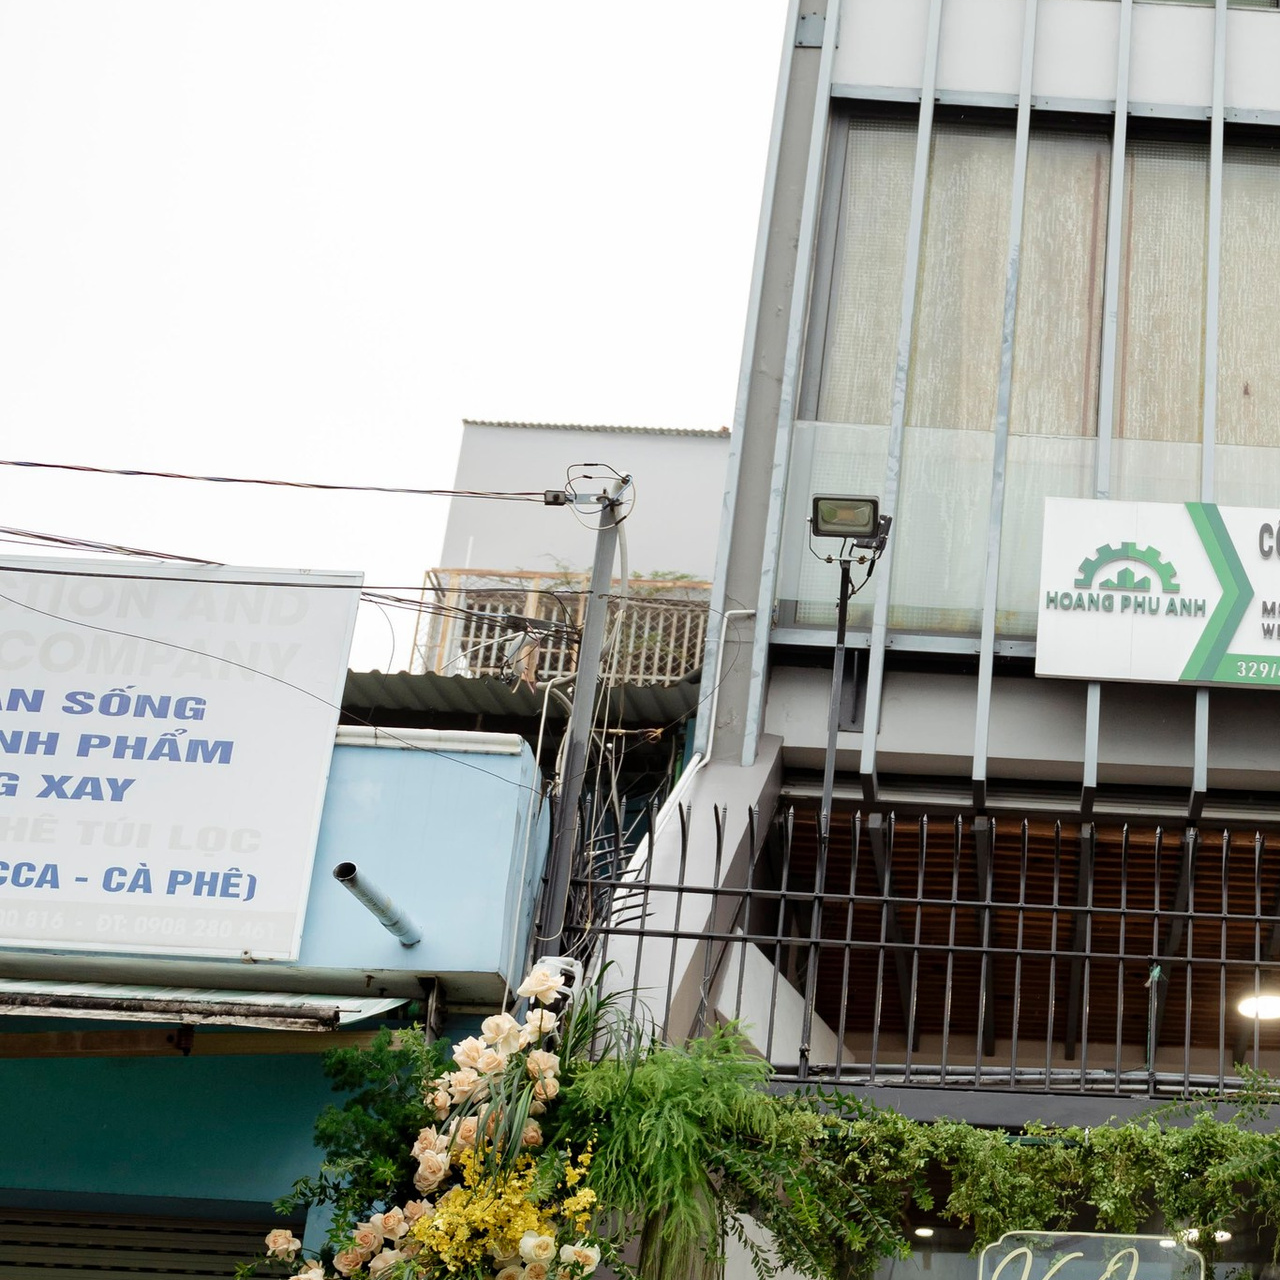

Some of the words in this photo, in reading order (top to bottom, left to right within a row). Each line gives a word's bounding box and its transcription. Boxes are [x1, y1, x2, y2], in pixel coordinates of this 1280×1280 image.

[1046, 590, 1114, 612] HOANG
[1121, 594, 1160, 615] PHU
[1166, 597, 1206, 617] ANH
[0, 688, 45, 712] N
[62, 685, 207, 721] SỐNG
[76, 728, 234, 764] PHẨM
[35, 774, 136, 802] XAY
[102, 862, 153, 894] CÀ
[166, 867, 258, 902] PHÊ)
